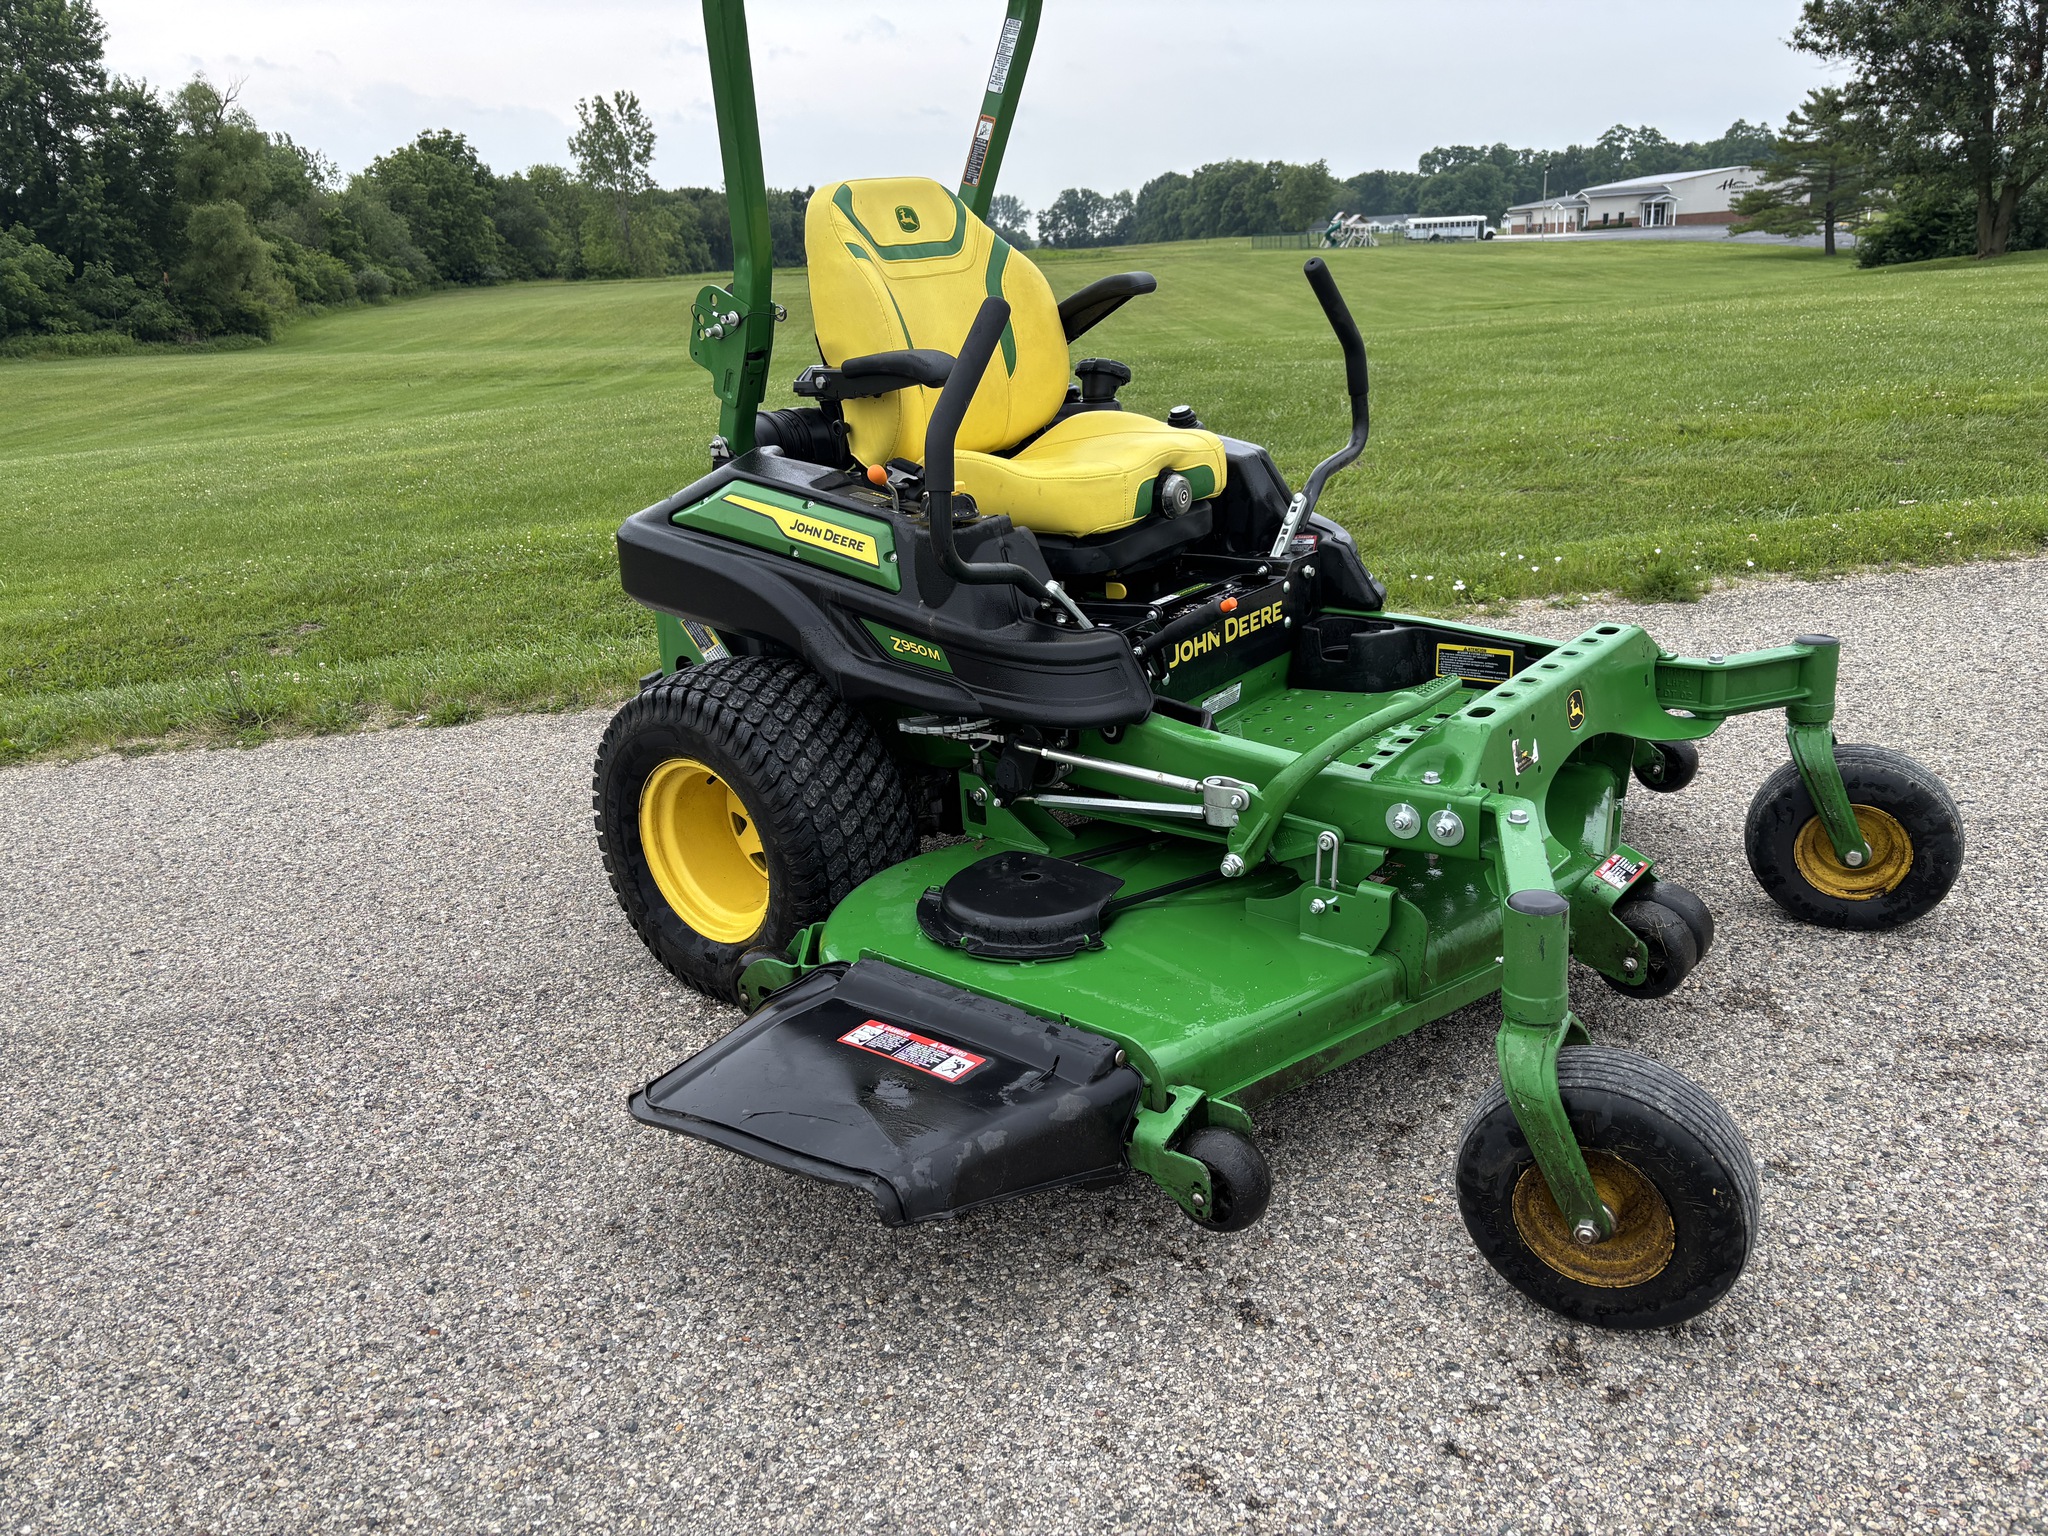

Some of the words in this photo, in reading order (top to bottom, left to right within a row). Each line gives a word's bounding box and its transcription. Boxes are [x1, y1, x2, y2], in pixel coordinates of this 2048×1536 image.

[790, 519, 822, 539] JOHN
[824, 529, 865, 552] DEERE
[890, 636, 941, 661] Z950M
[1169, 631, 1220, 669] JOHN
[1225, 600, 1283, 643] DEERE
